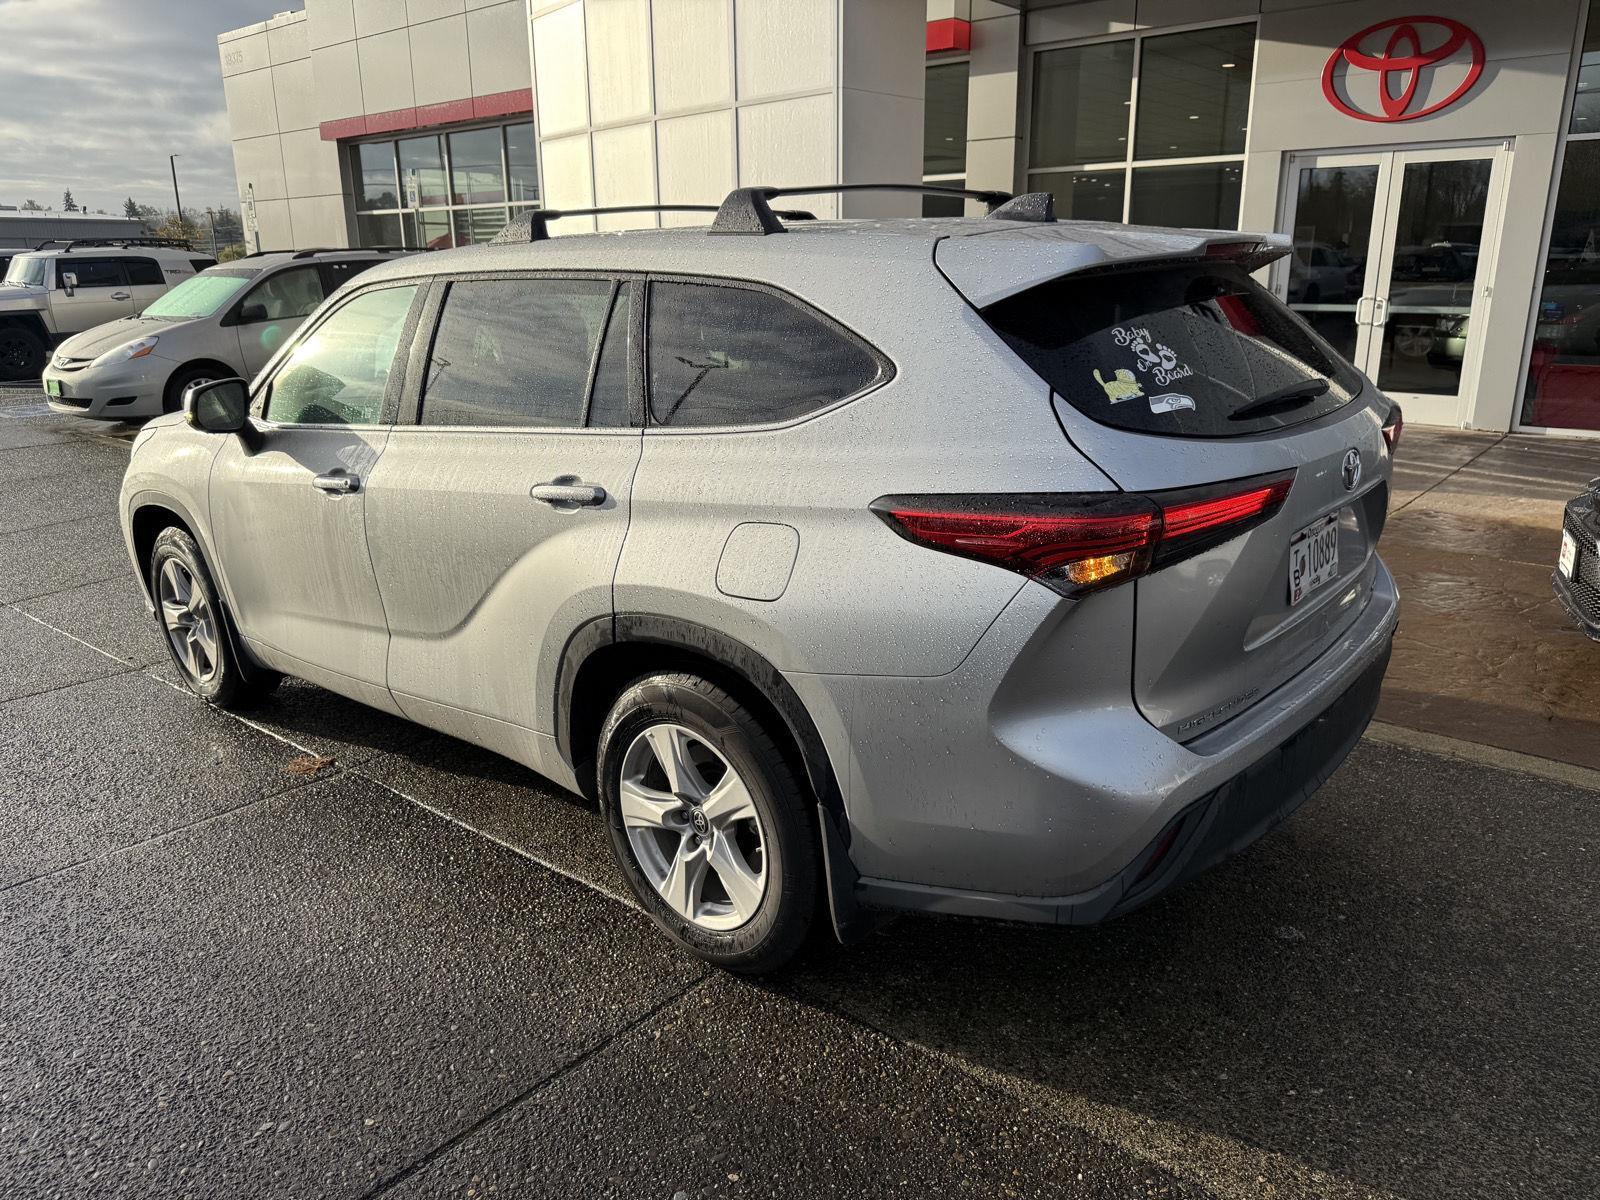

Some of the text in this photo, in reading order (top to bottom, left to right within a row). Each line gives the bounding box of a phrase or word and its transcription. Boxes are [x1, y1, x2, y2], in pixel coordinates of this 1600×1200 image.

[1111, 326, 1151, 346] Baby
[1152, 363, 1193, 386] Board
[1307, 526, 1337, 578] 10889
